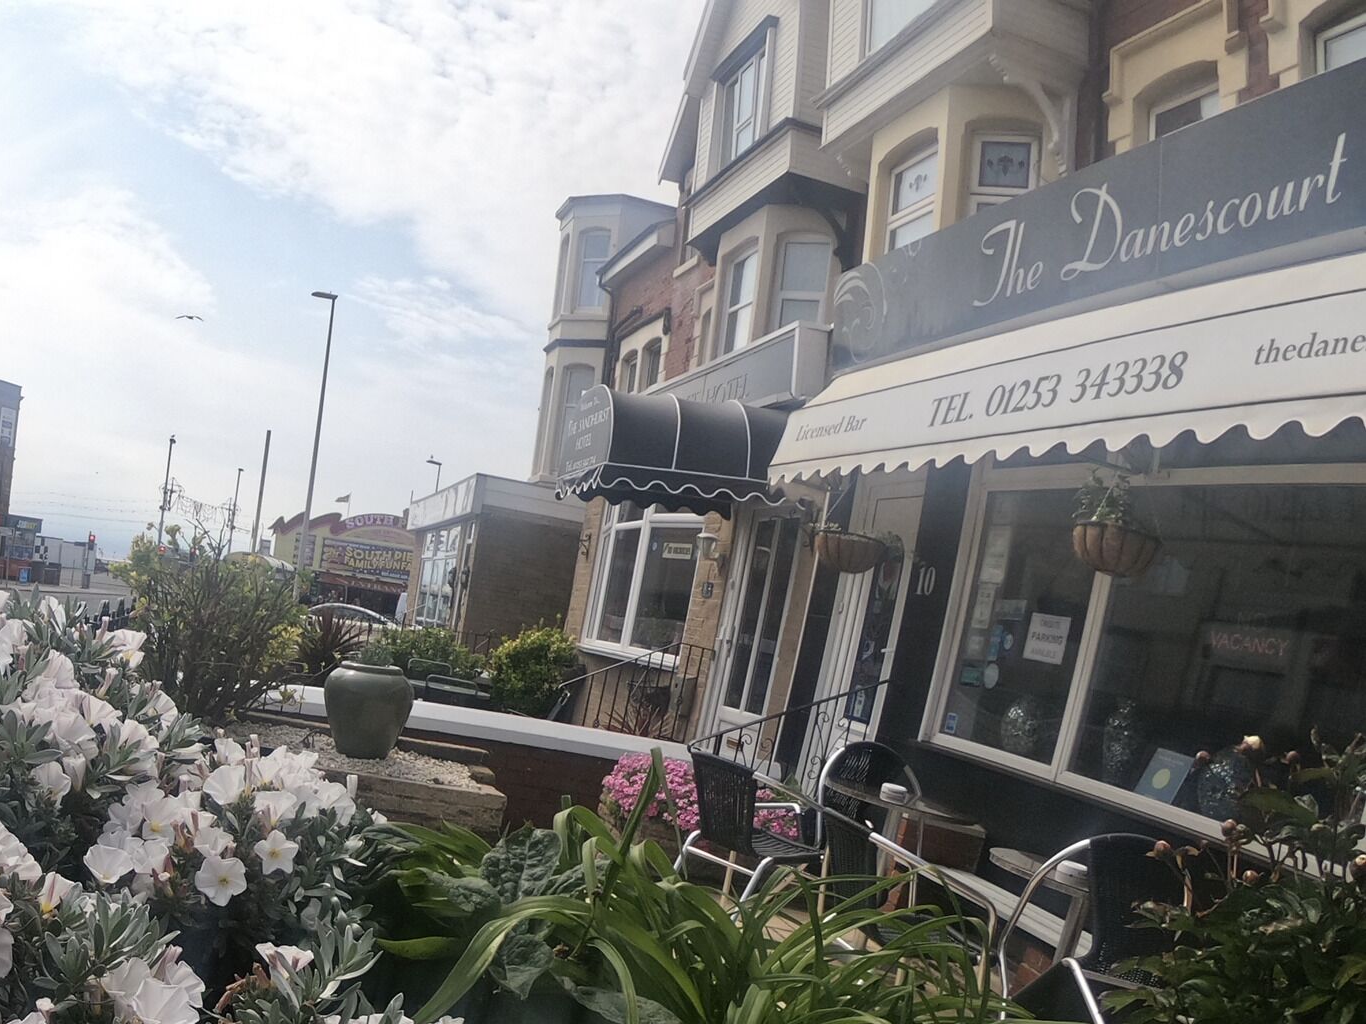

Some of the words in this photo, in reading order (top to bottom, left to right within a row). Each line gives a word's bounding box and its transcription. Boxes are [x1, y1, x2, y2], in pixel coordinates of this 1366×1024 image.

[973, 219, 1043, 308] The
[1059, 131, 1348, 282] Danescourt
[795, 416, 846, 442] Licensed
[843, 415, 868, 433] Bar
[927, 391, 974, 428] TEL.
[984, 373, 1062, 418] 01253
[1069, 350, 1190, 405] 343338
[1254, 331, 1366, 366] thedane
[345, 514, 395, 529] SOUTH
[345, 546, 392, 560] SOUTH
[394, 550, 414, 562] PIE
[379, 558, 411, 571] FUNFA
[915, 566, 936, 596] 10
[1030, 631, 1064, 646] PARKING
[1209, 630, 1291, 657] VACANCY
